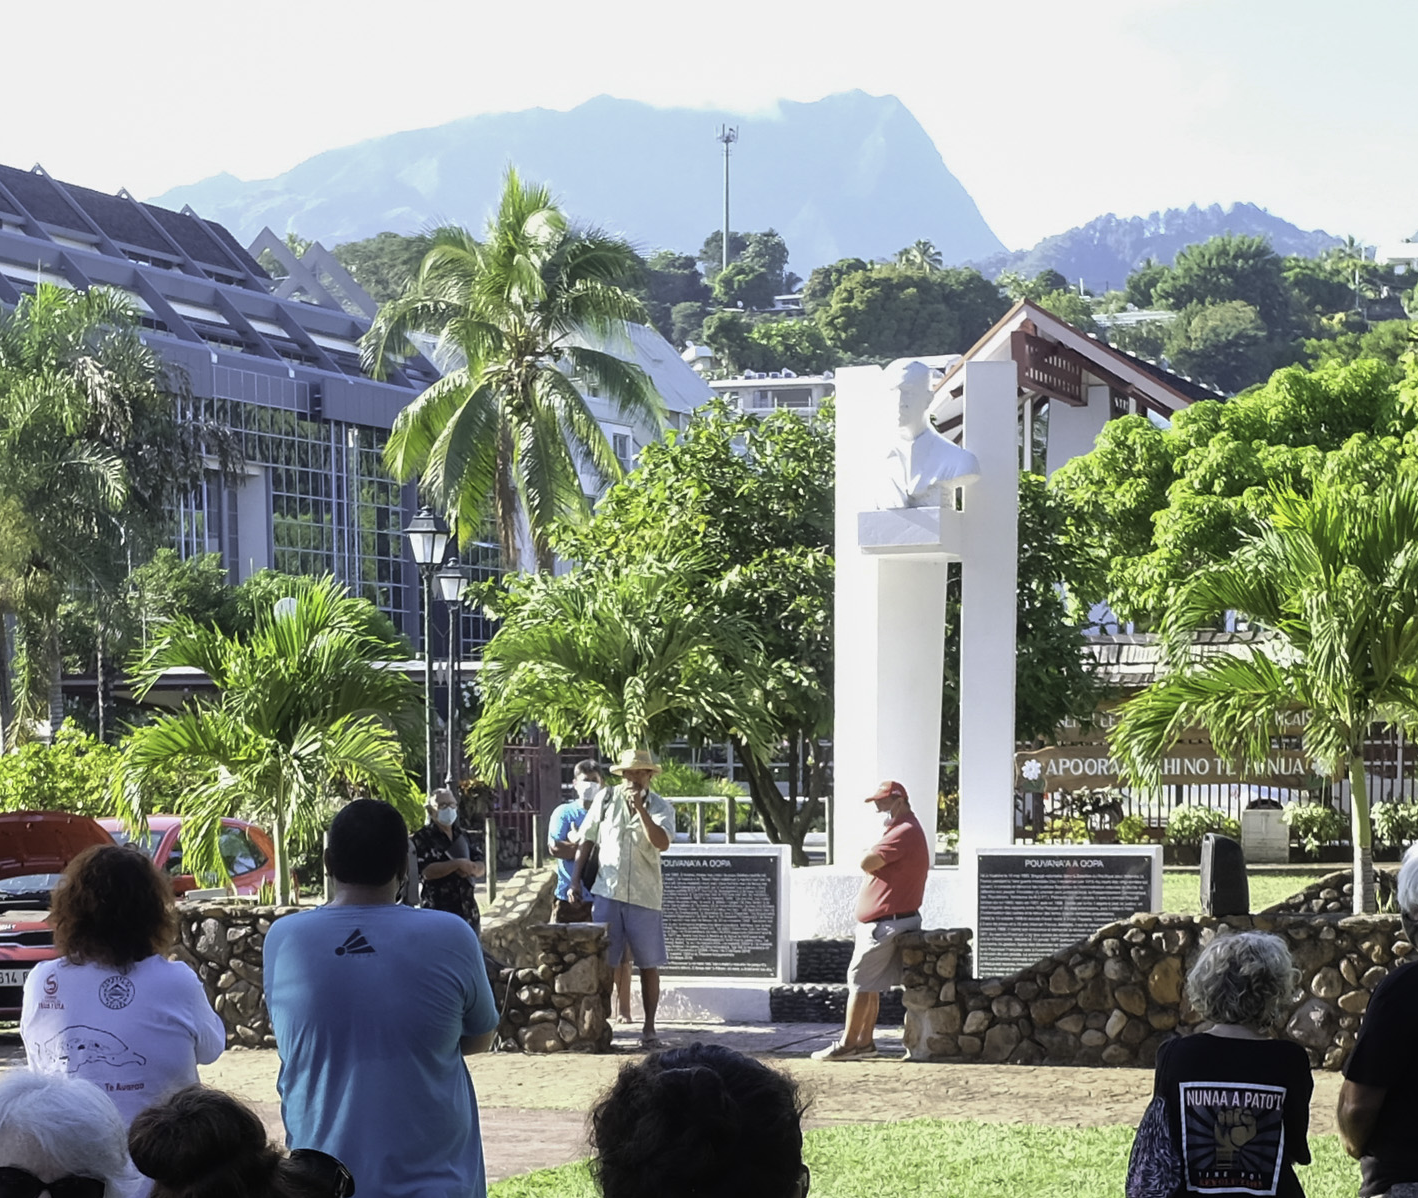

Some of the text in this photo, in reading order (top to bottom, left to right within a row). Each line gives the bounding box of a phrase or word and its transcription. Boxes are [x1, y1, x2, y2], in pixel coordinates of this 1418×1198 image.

[1183, 757, 1210, 776] NO
[1186, 1089, 1228, 1107] NUNAA
[1231, 1090, 1241, 1107] A
